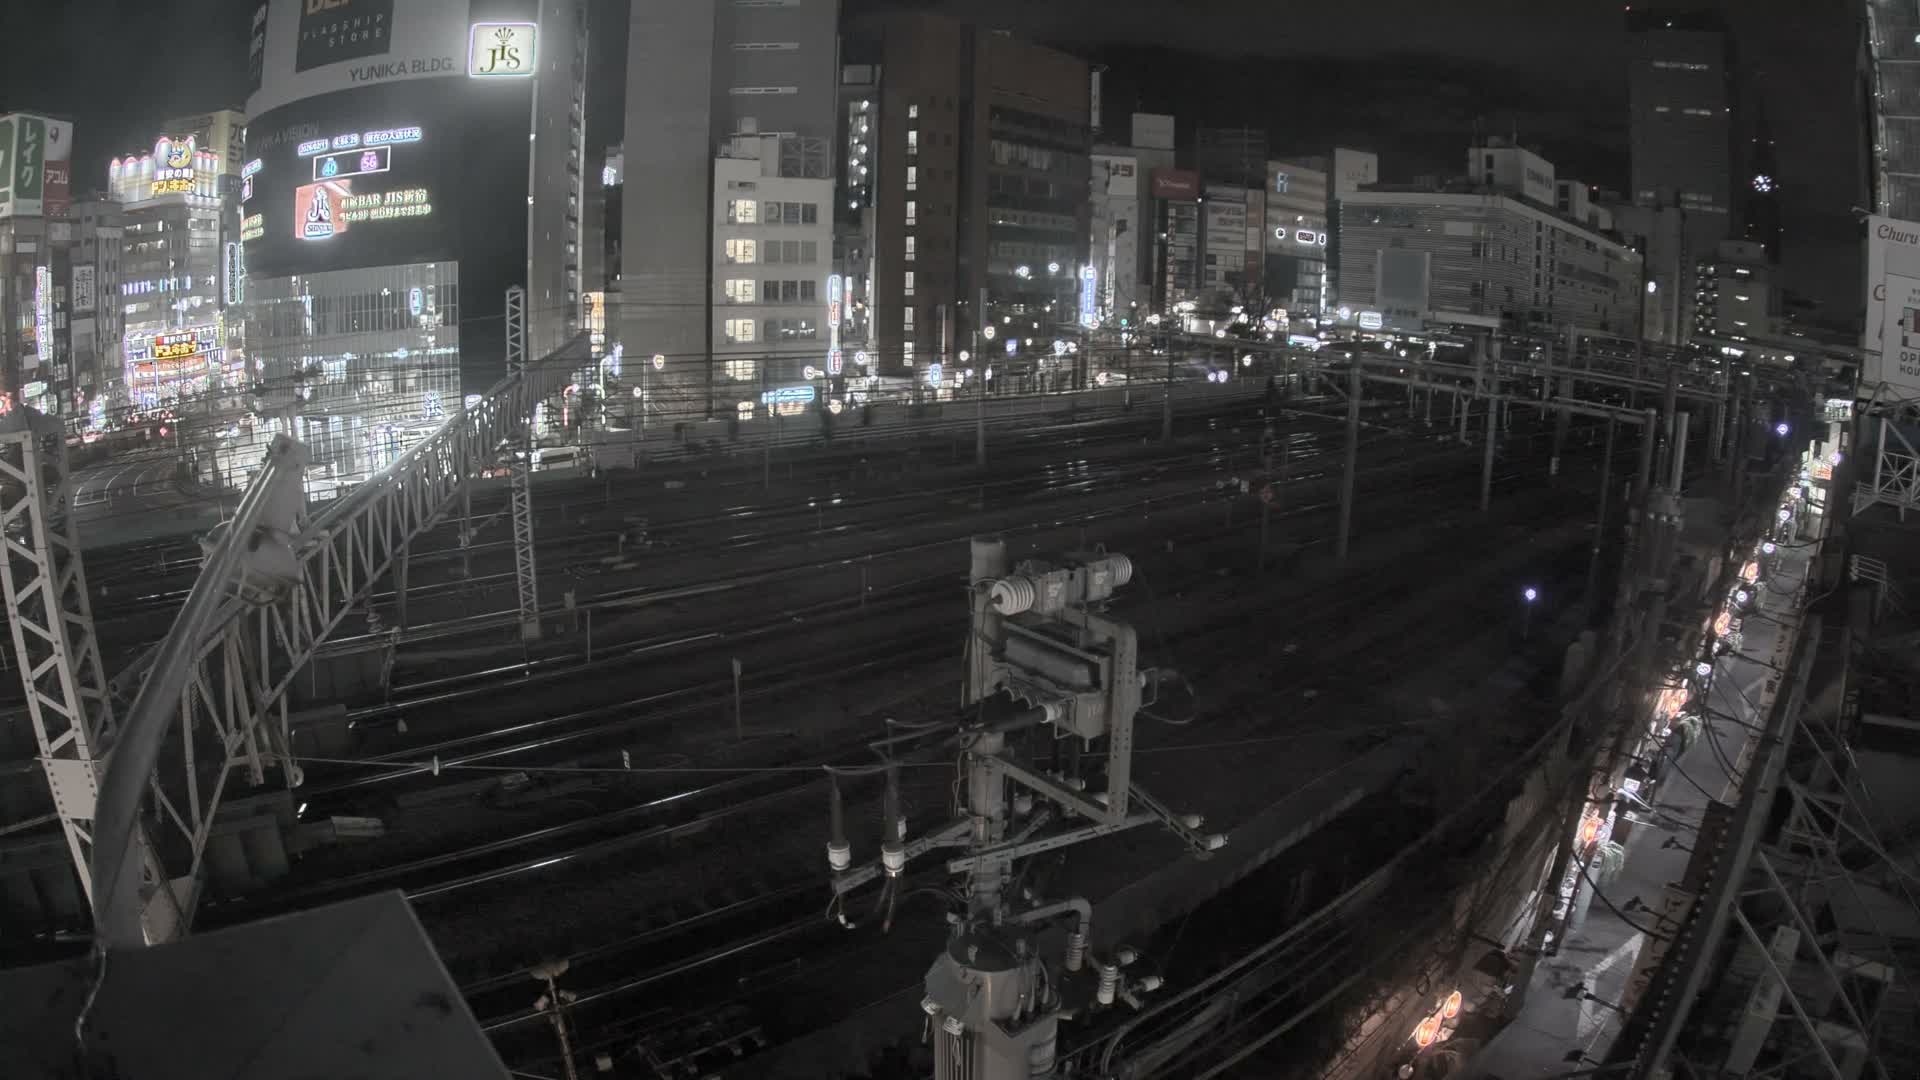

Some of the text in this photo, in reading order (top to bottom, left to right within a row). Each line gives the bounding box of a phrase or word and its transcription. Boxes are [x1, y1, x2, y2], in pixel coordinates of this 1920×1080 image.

[303, 13, 384, 41] FLAGSHIP
[328, 27, 383, 48] STORE
[480, 44, 521, 73] JIS
[350, 60, 408, 82] YUNIKA
[21, 121, 38, 187] レイク
[46, 169, 68, 184] アコム
[1878, 223, 1919, 245] Churu
